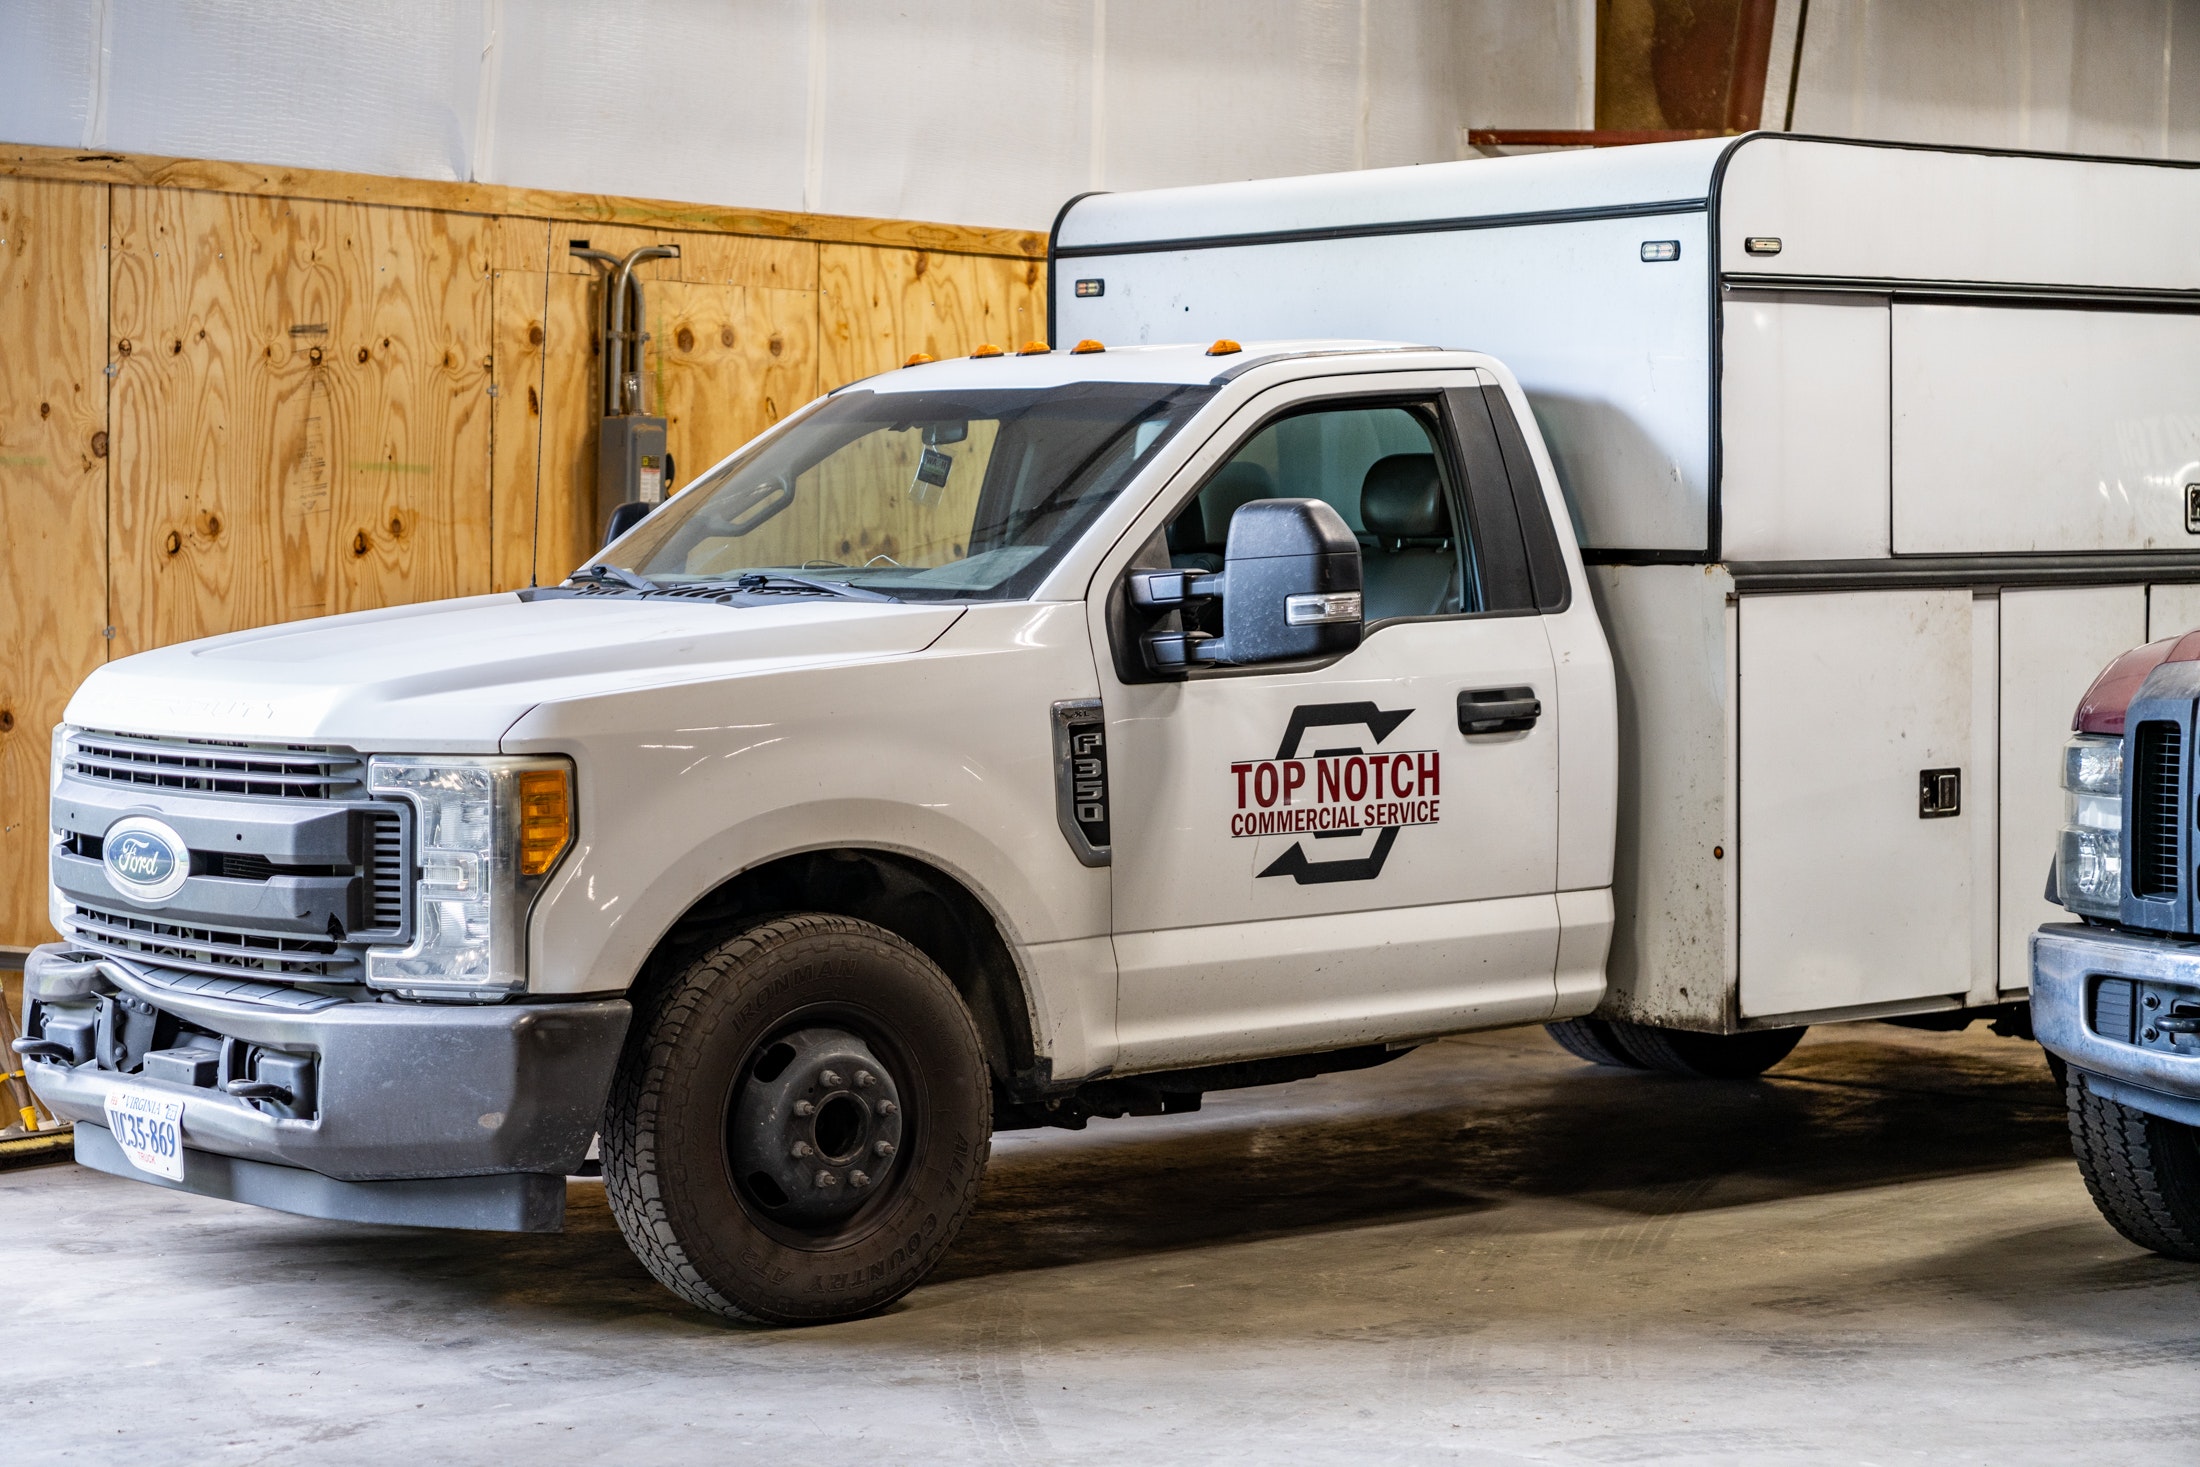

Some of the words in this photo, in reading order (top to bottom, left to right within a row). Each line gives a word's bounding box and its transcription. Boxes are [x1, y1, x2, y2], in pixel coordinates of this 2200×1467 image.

[1073, 732, 1104, 822] F350
[1231, 761, 1306, 809] TOP
[1317, 752, 1440, 803] NOTCH
[1231, 806, 1360, 836] COMMERCIAL
[1364, 800, 1440, 826] SERVICE
[118, 838, 159, 875] Ford
[731, 959, 858, 1034] IRONMAN
[125, 1095, 161, 1115] VIRGINIA
[137, 1151, 156, 1164] TRUCK
[939, 1131, 969, 1198] ALL
[739, 1247, 796, 1285] AT2
[804, 1213, 937, 1293] COUNTRY
